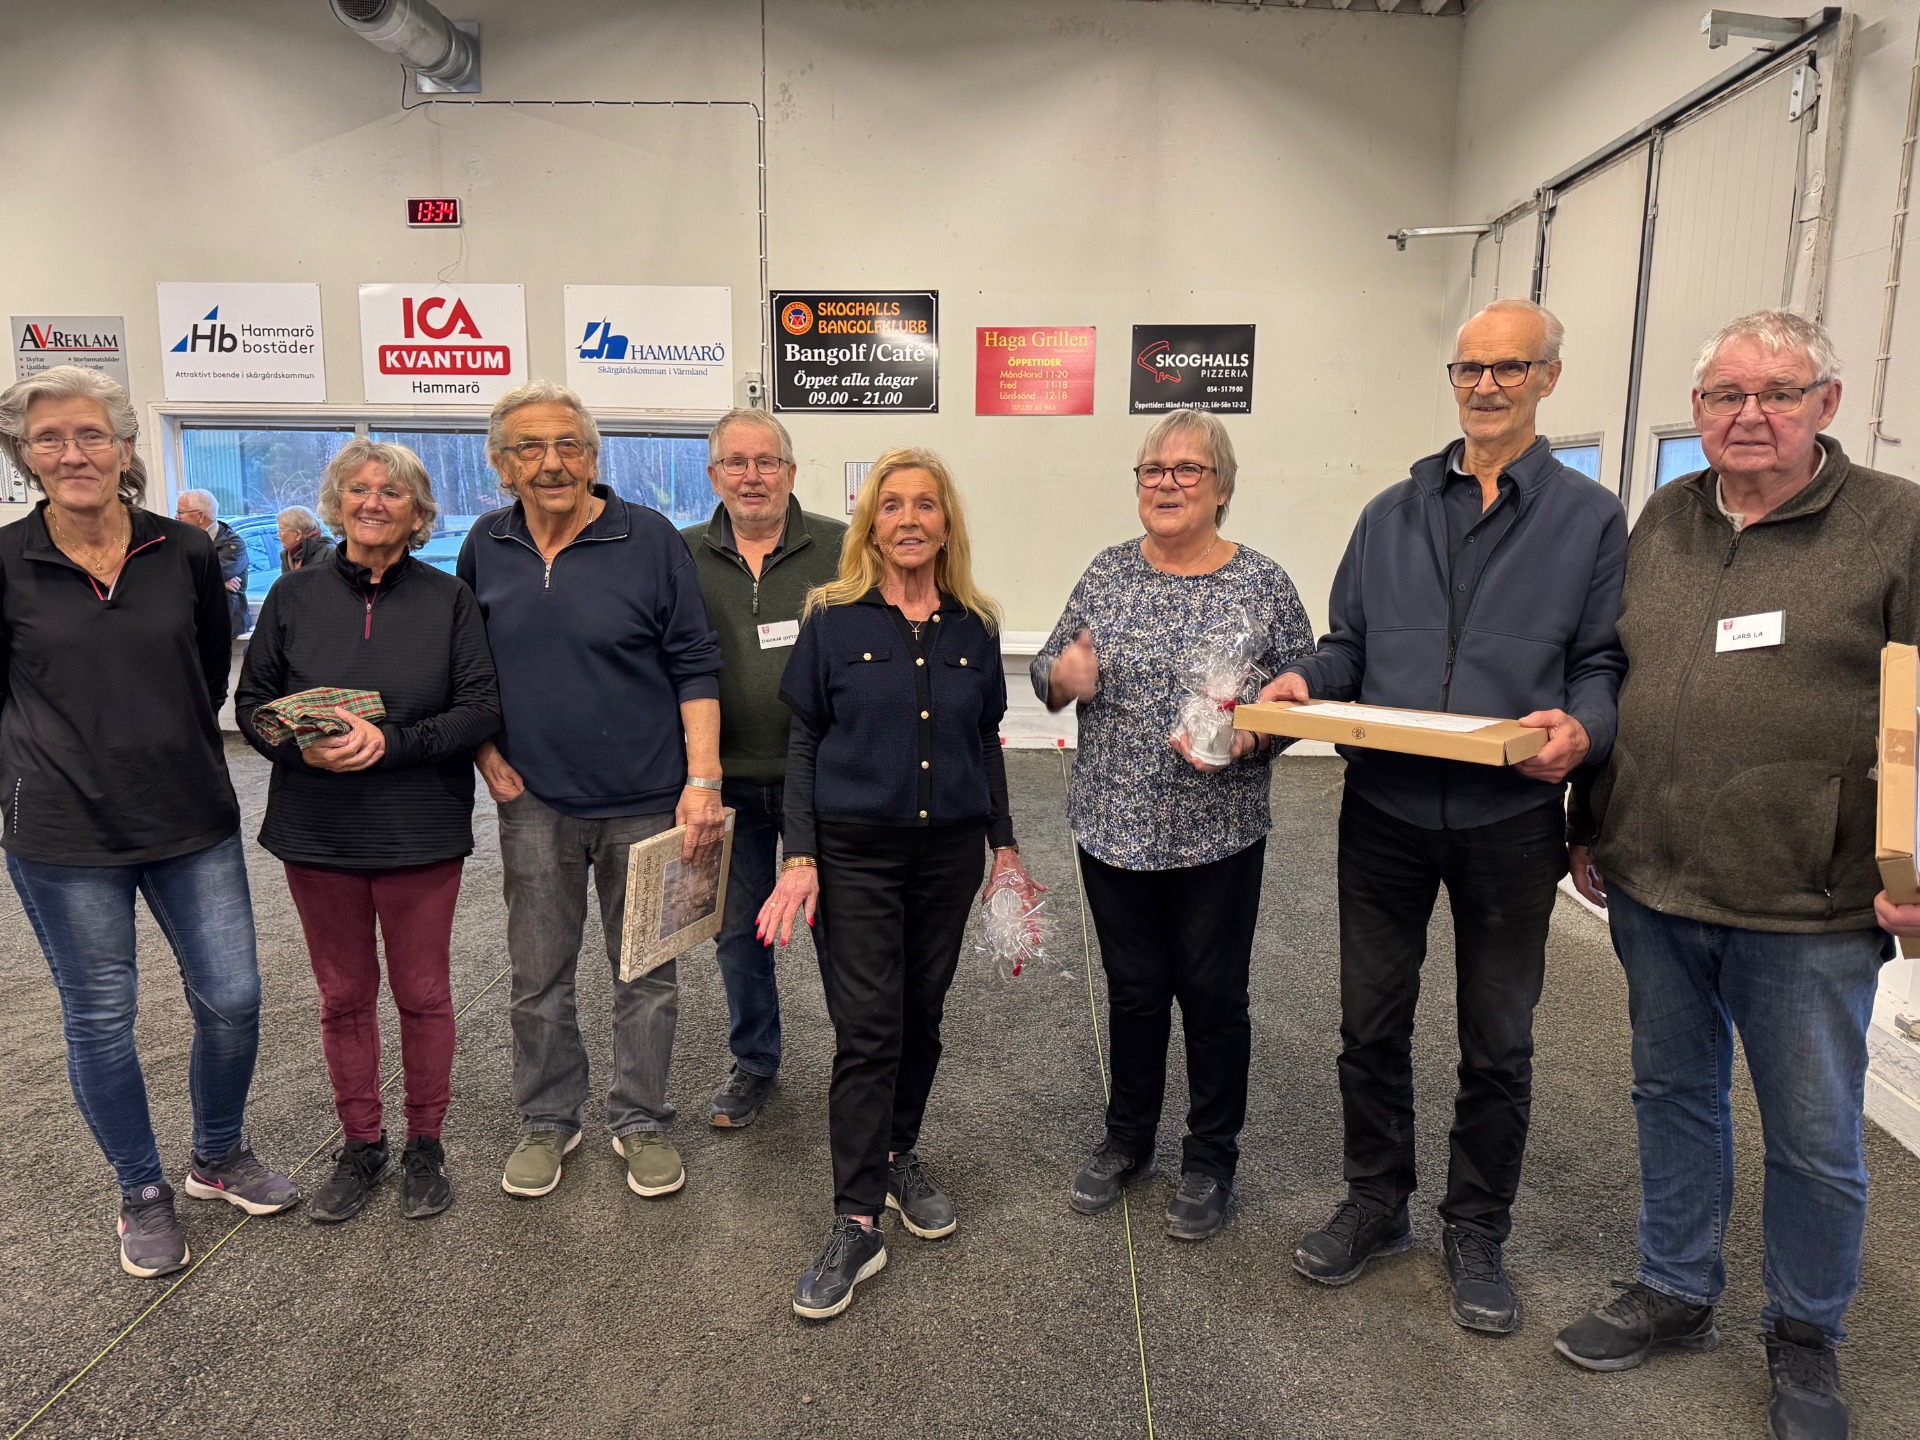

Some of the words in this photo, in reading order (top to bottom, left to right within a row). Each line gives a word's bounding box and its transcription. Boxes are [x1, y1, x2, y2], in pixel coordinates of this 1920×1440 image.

[417, 201, 454, 222] 13:34
[817, 302, 901, 316] SKOGHALLS
[402, 297, 483, 339] ICA
[241, 323, 315, 338] Hammarö
[818, 319, 928, 334] BANGOLFKLUBB
[190, 323, 238, 353] Hb
[984, 331, 1027, 351] Haga
[1031, 330, 1088, 347] Grillen
[242, 339, 315, 354] bostäder
[630, 342, 725, 361] HAMMARÖ
[25, 356, 45, 364] Skyltar
[385, 350, 504, 369] KVANTUM
[784, 343, 867, 366] Bangolf
[1007, 356, 1062, 367] ÖPPETTIDER
[1155, 353, 1249, 368] SKOGHALLS
[175, 370, 211, 379] Attraktivt
[213, 371, 240, 379] boende
[245, 370, 315, 381] skärgårdskommun
[597, 365, 667, 376] Skärgårdskommun
[673, 367, 708, 376] Värmland
[999, 370, 1043, 379] Månd-torsd
[1045, 370, 1068, 379] 11-20
[1200, 369, 1249, 378] PIZZERIA
[793, 369, 838, 389] Öppet
[841, 373, 870, 386] alla
[874, 373, 919, 389] dagar
[999, 381, 1017, 389] Fred
[1045, 381, 1068, 389] 11-18
[412, 381, 480, 394] Hammarö
[808, 391, 849, 405] 09.00
[862, 391, 903, 405] 21.00
[999, 391, 1036, 400] Lörd-sönd
[1045, 391, 1068, 400] 12-18
[1134, 401, 1165, 410] Öppettider:
[1732, 632, 1751, 641] LARS
